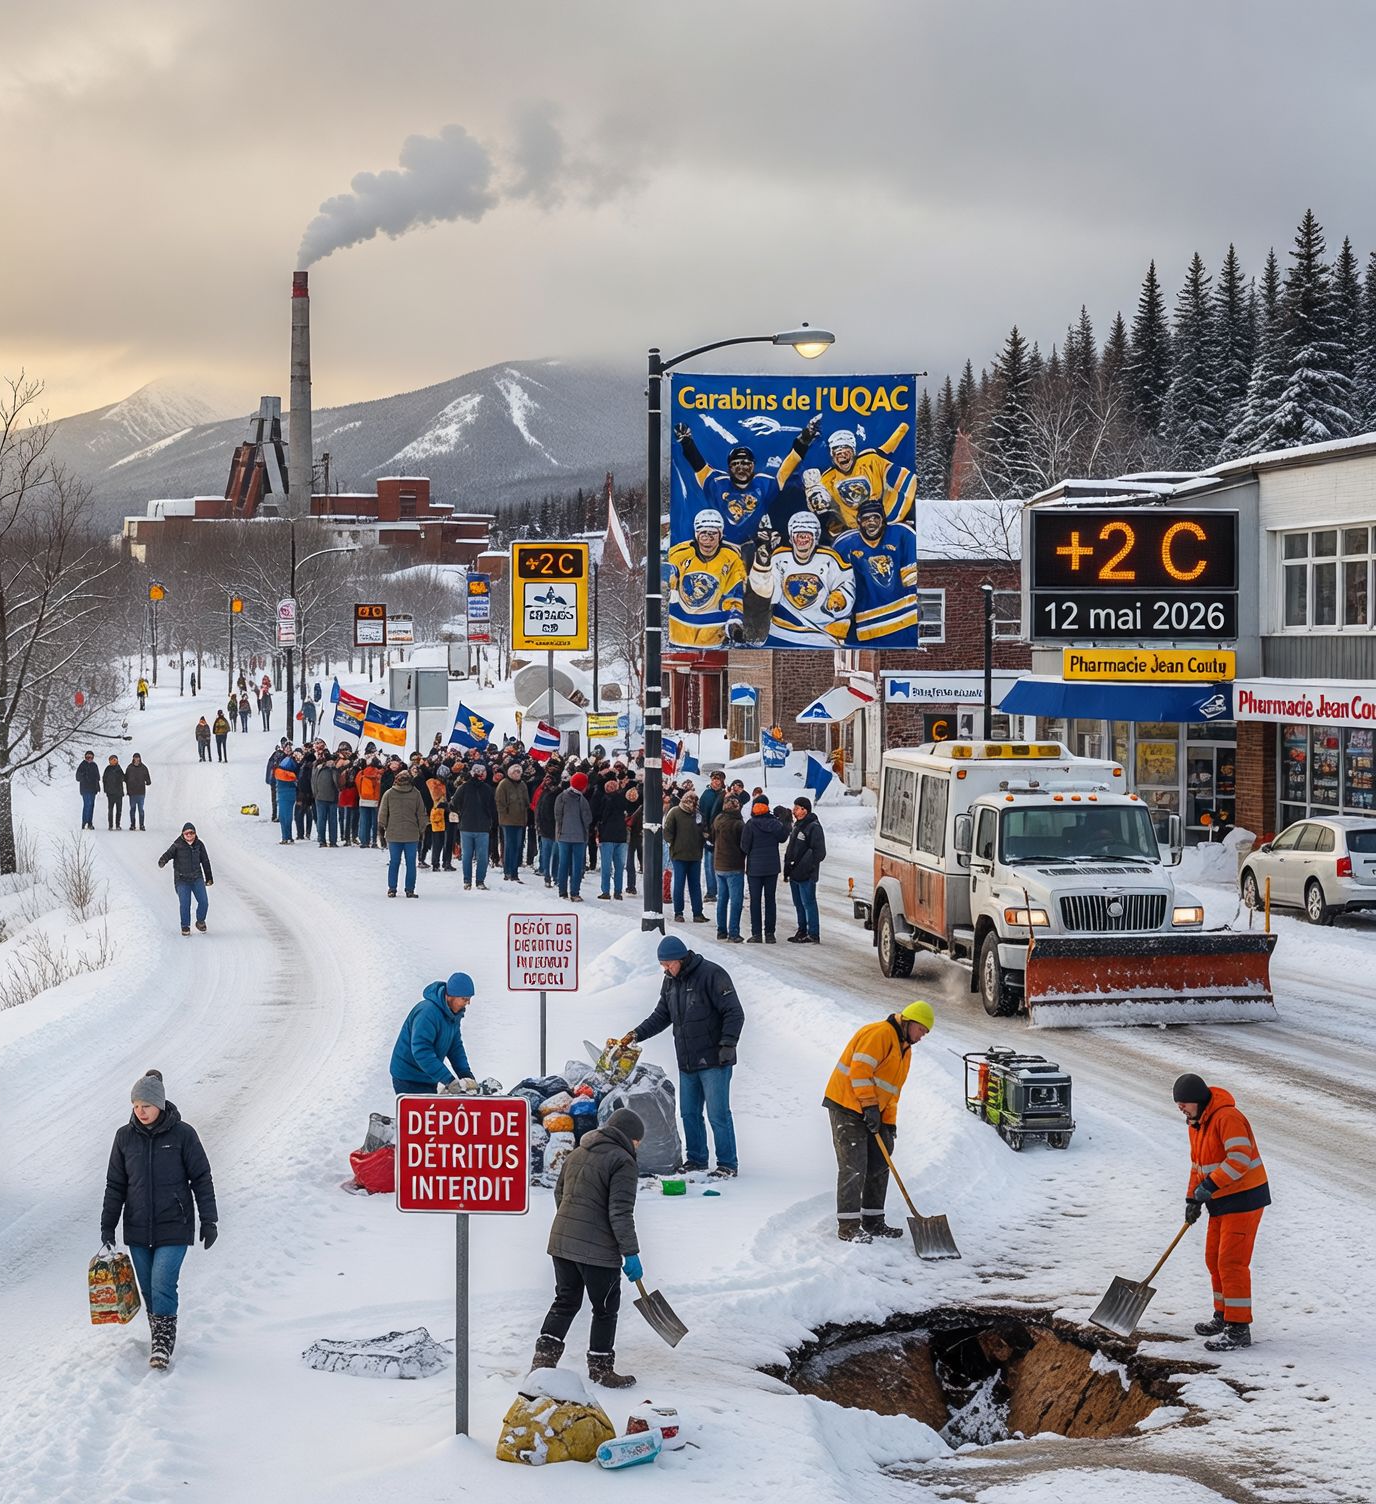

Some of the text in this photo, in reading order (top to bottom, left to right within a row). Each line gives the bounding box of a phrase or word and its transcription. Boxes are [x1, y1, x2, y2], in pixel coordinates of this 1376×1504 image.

[678, 385, 909, 416] Carabins de l'UQAC
[1056, 521, 1208, 581] +2 C
[1044, 601, 1225, 630] 12 mai 2026
[1070, 655, 1147, 673] Pharmacie
[1151, 654, 1184, 674] Jean
[1238, 690, 1314, 718] Pharmacie
[1316, 694, 1349, 719] Jean
[407, 1103, 520, 1137] DÉPÔT DE
[407, 1136, 520, 1170] DÉTRITUS
[411, 1175, 514, 1201] INTERDIT
